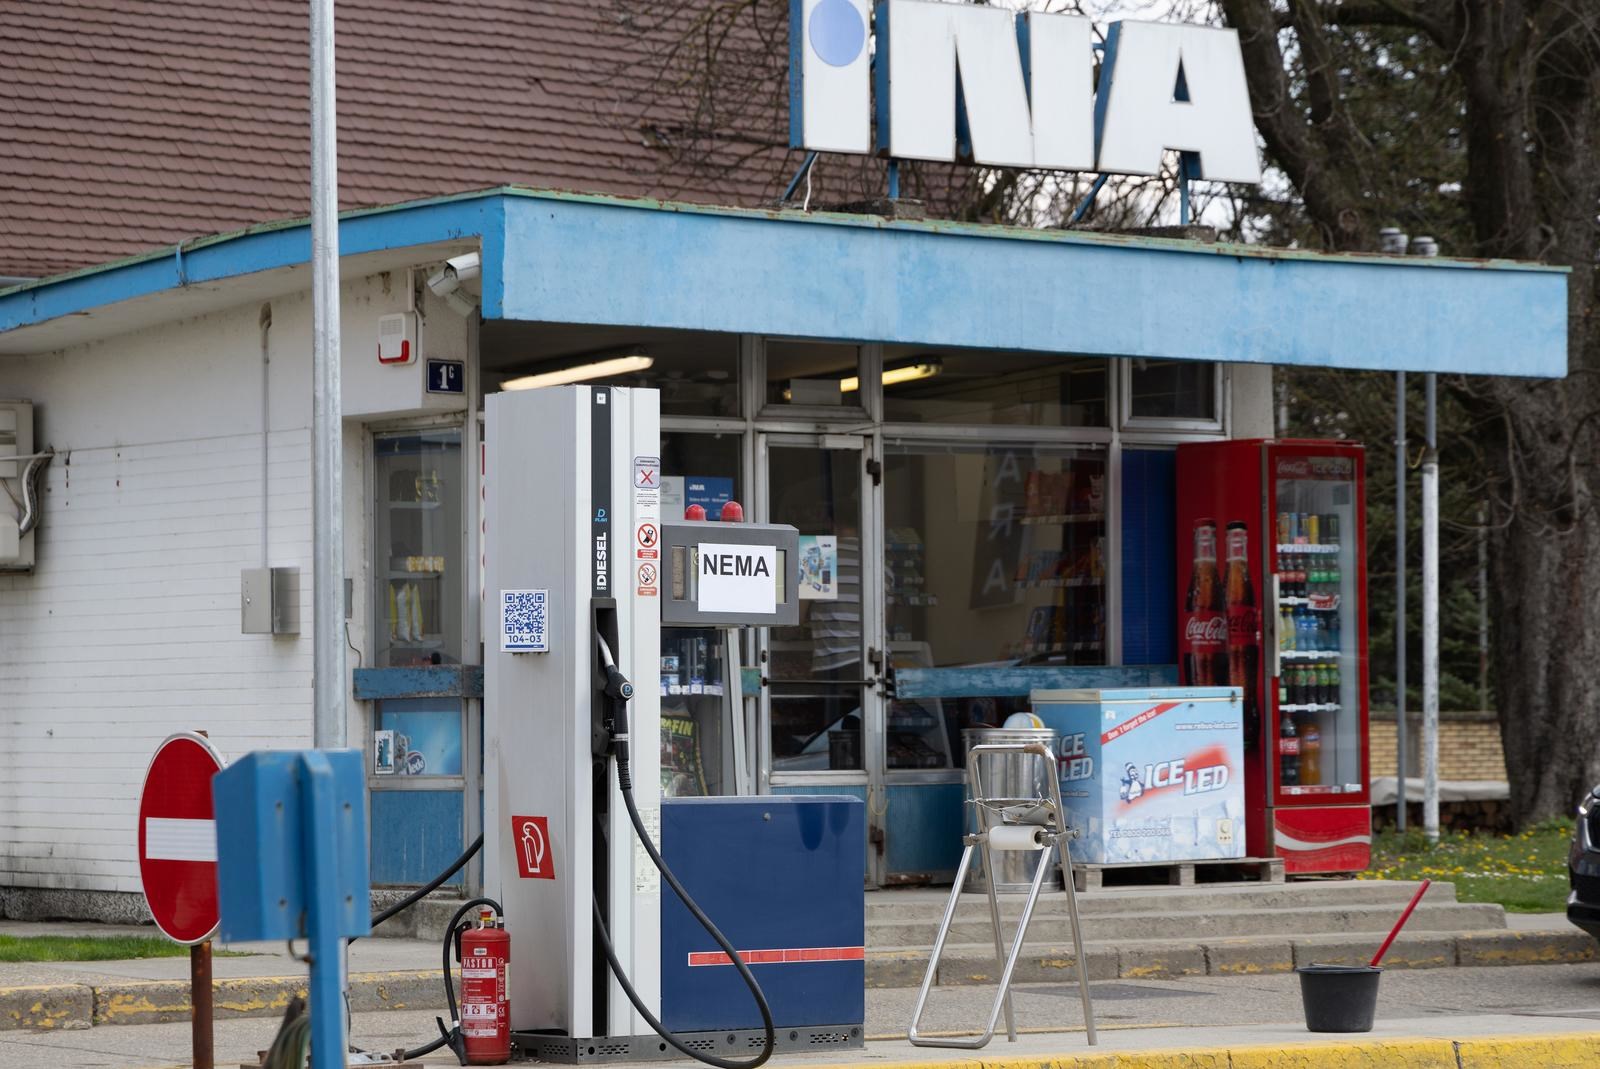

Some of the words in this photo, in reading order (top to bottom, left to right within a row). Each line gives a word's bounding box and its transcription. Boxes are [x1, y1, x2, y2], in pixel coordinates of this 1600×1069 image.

[596, 532, 607, 586] DIESEL
[703, 554, 770, 577] NEMA
[508, 635, 542, 643] 104-03
[1061, 757, 1093, 782] LED
[1143, 758, 1186, 790] ICE
[1184, 764, 1229, 796] LED
[463, 958, 493, 968] PASTOR
